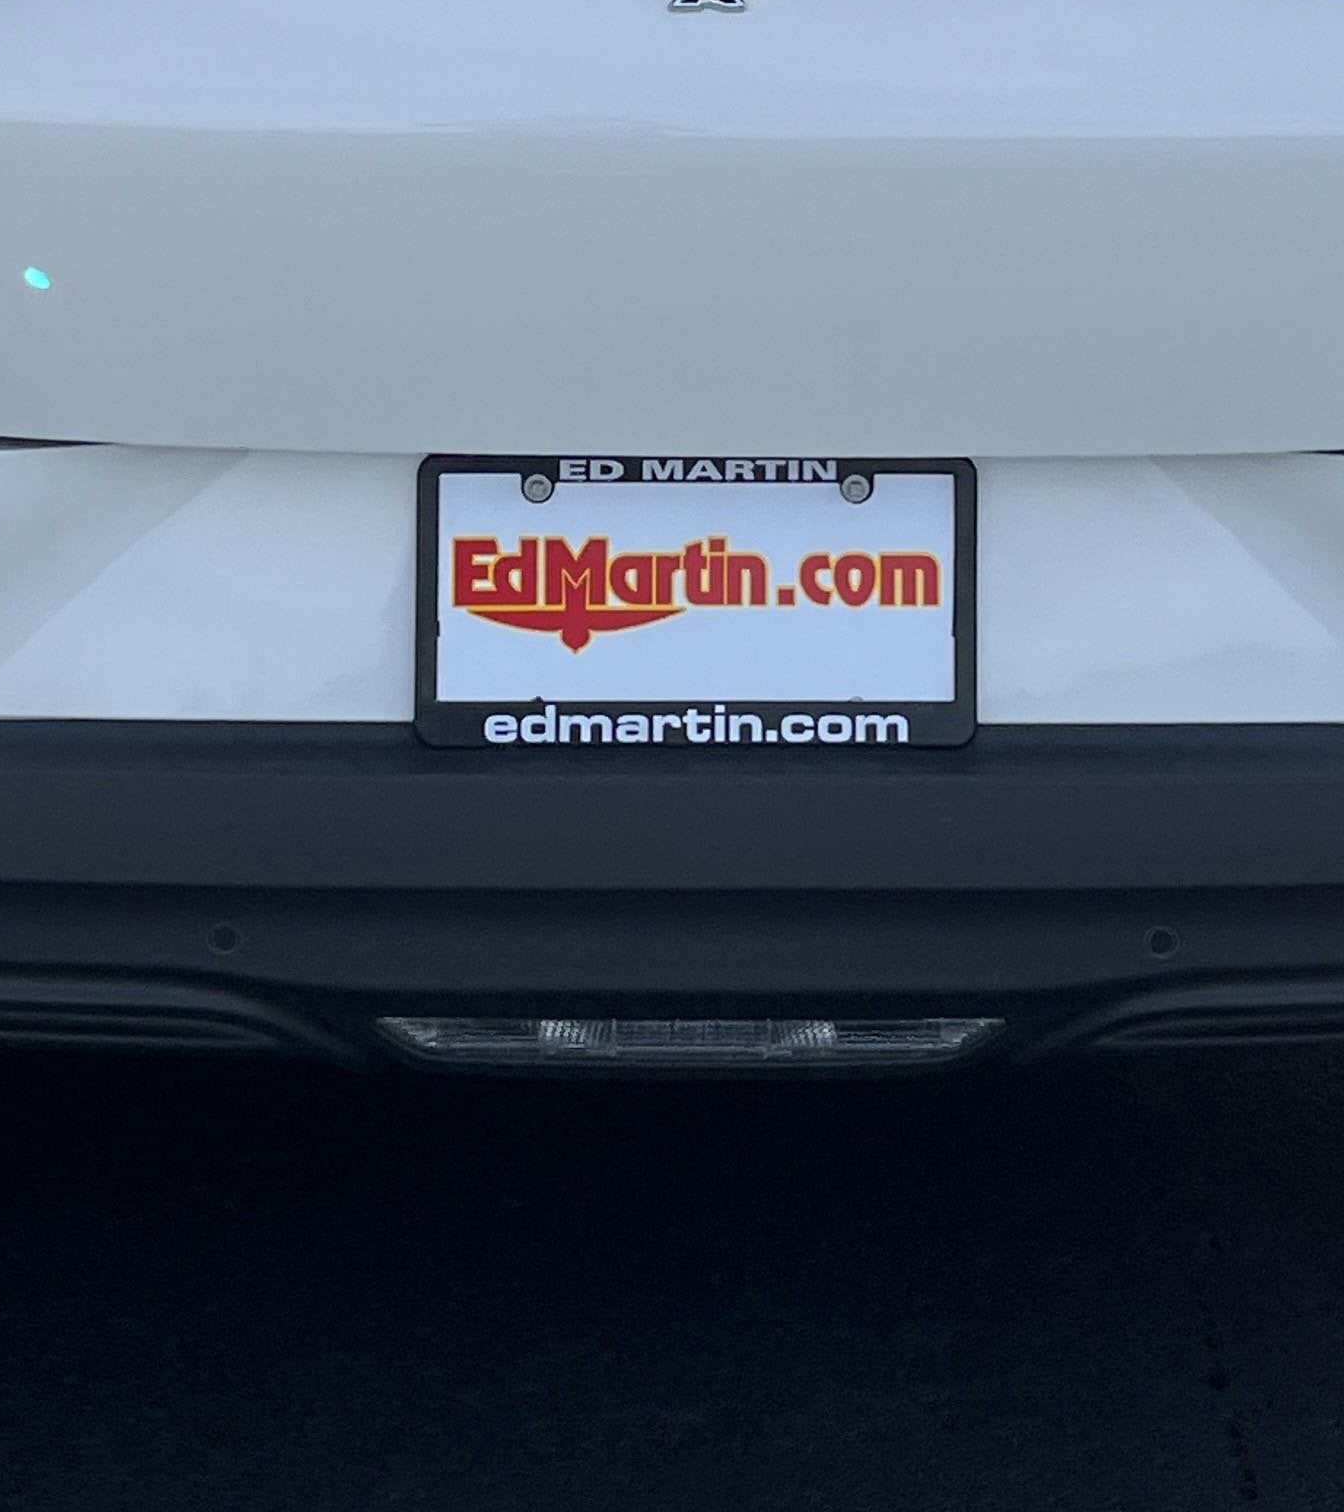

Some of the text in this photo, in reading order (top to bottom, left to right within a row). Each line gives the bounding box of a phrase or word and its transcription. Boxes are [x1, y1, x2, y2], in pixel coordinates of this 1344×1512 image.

[559, 459, 838, 481] ED MARTIN
[483, 705, 909, 744] edmartin.com
